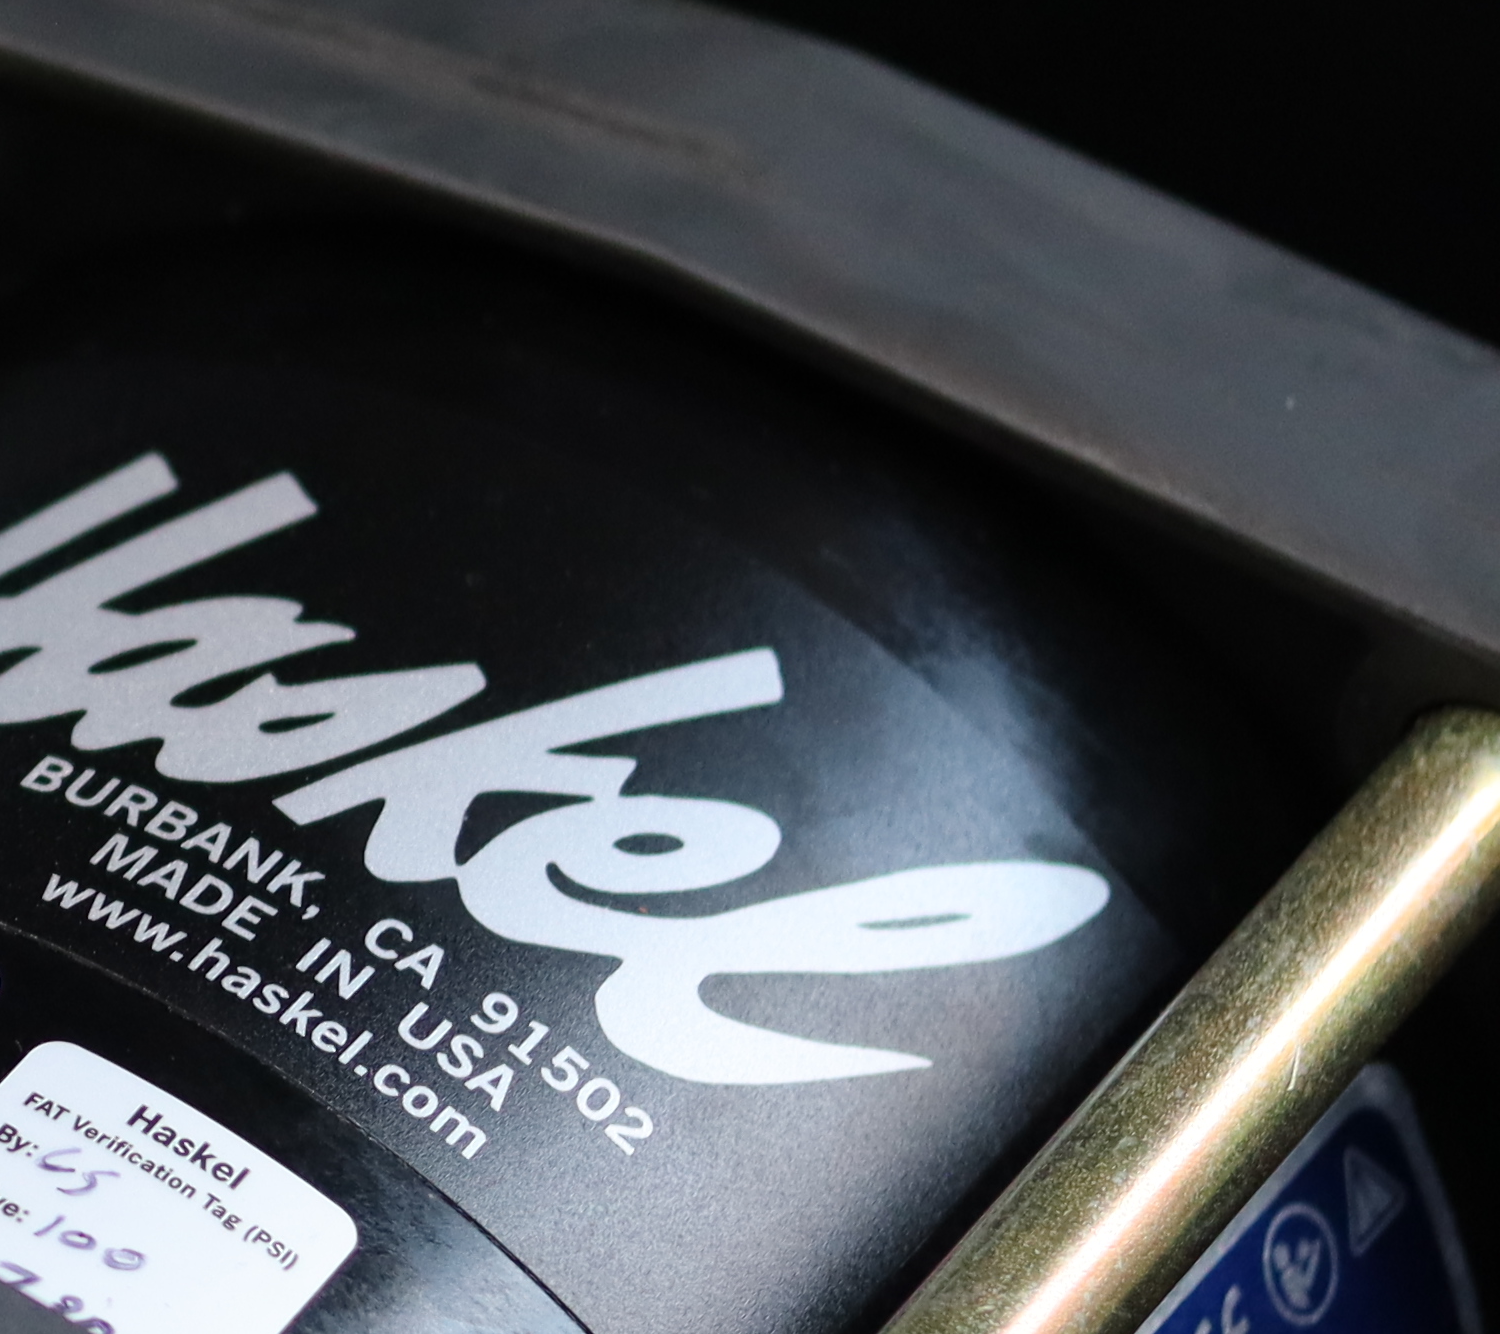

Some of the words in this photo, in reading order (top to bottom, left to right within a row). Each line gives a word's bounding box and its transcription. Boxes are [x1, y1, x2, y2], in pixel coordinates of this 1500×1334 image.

[20, 756, 324, 920] BURBANK,
[364, 918, 447, 989] CA
[471, 992, 653, 1156] 91502
[42, 874, 488, 1159] www.haskel.com
[90, 835, 277, 941] MADE
[296, 938, 375, 1000] IN
[397, 1003, 522, 1111] USA
[23, 1092, 70, 1121] FAT
[73, 1115, 196, 1199] Verification
[202, 1194, 242, 1231] Tag
[243, 1224, 299, 1271] (PSI)
[34, 1214, 146, 1271] 100
[126, 1105, 251, 1190] Haskel
